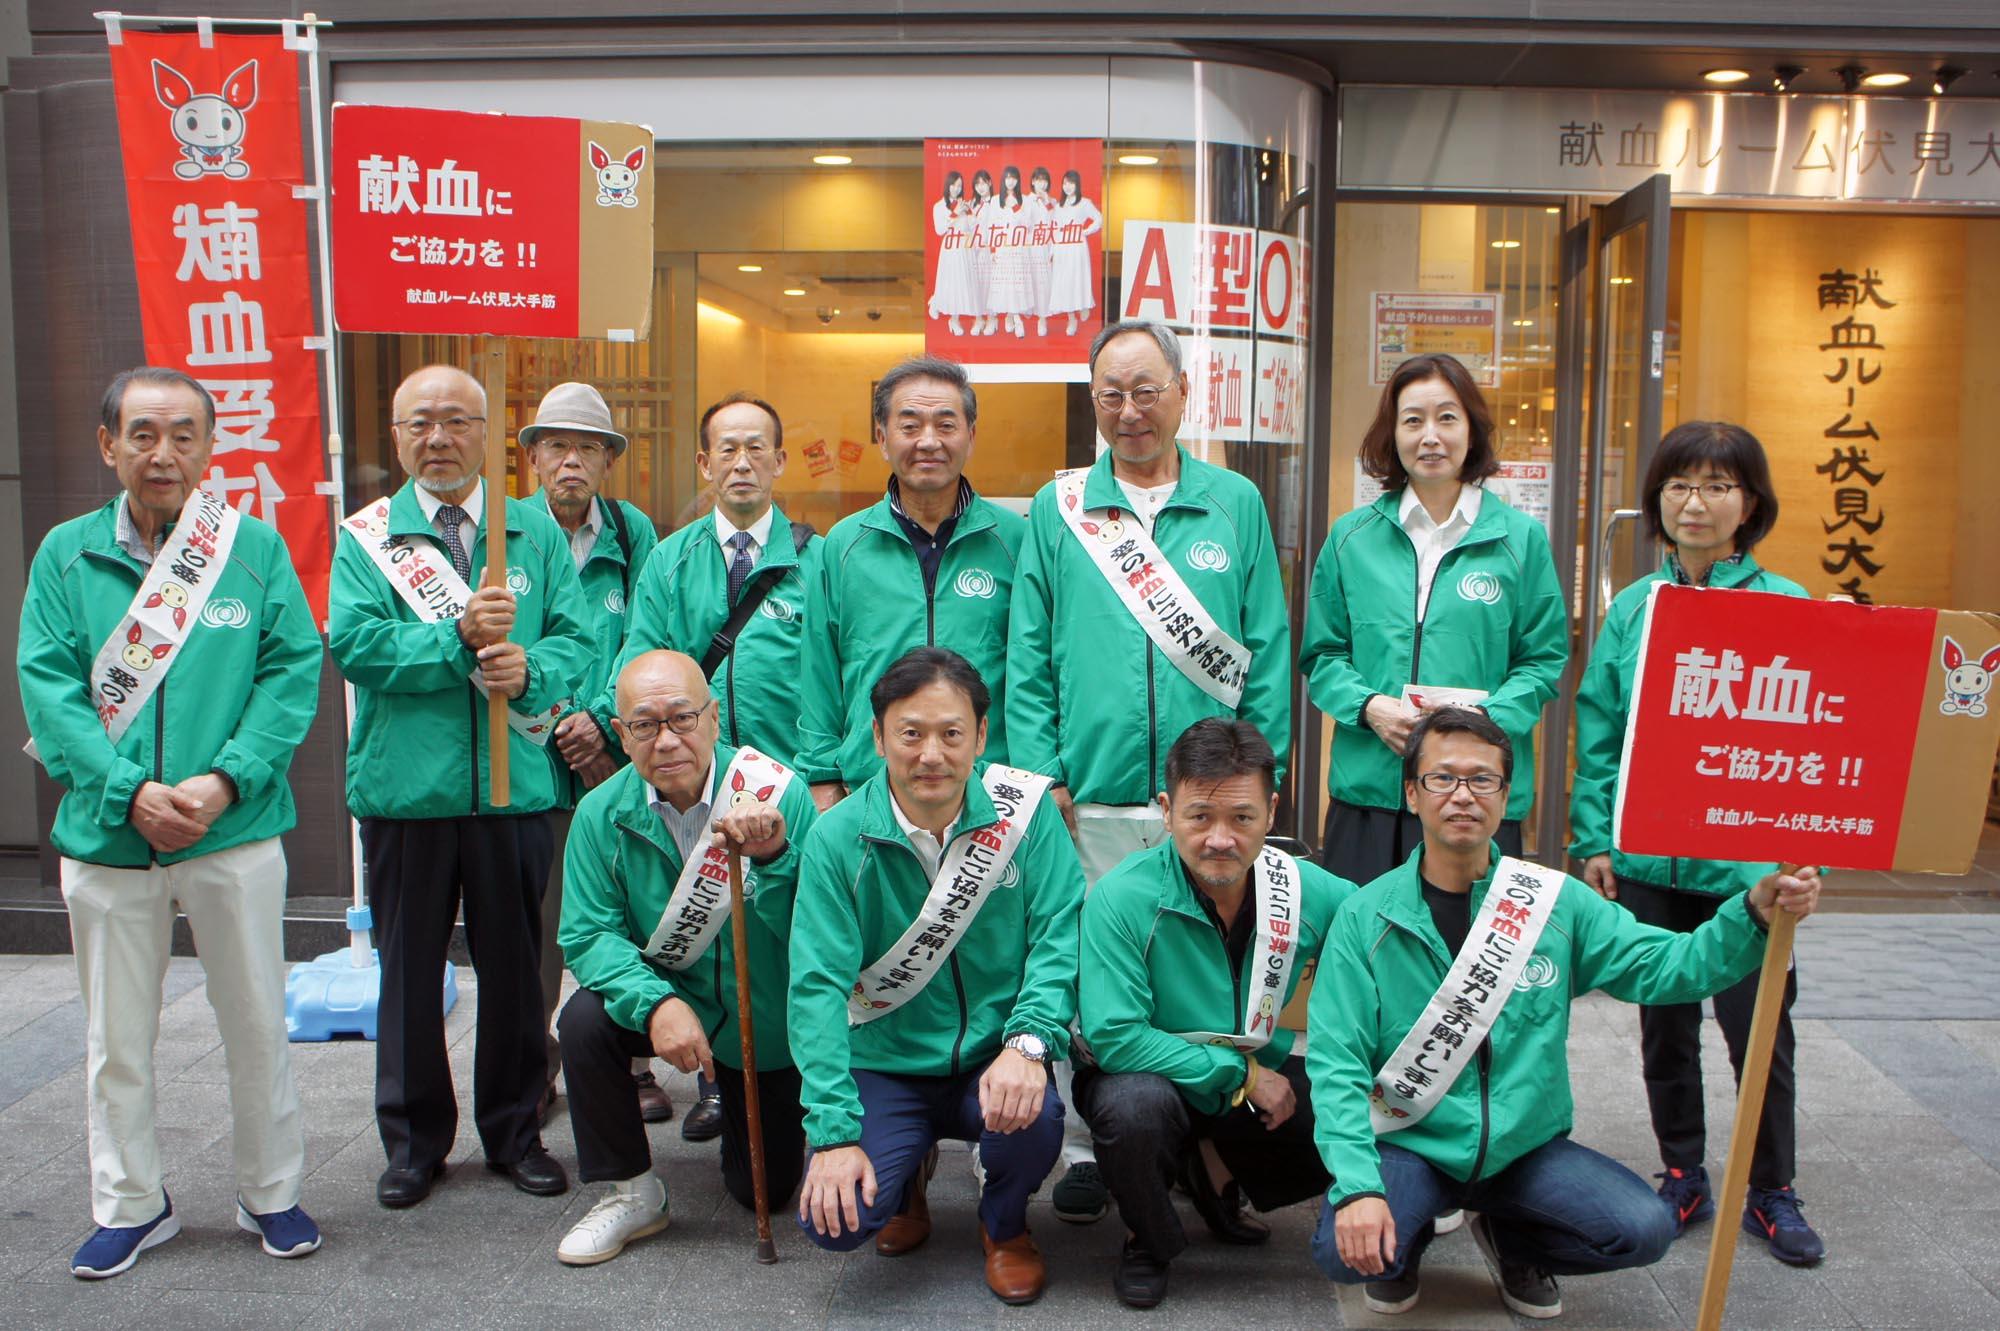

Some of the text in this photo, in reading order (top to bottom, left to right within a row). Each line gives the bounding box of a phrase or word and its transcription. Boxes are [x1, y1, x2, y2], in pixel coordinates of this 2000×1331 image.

[358, 154, 513, 216] 献血に
[390, 235, 504, 267] ご協力を
[944, 219, 1083, 250] みんなの献血
[406, 288, 556, 309] 献血ルーム伏見大手筋
[1669, 647, 1845, 724] 献血に
[1696, 745, 1825, 785] ご協力を
[1706, 807, 1874, 836] 献血ルーム伏見大手筋
[1394, 873, 1543, 1100] 愛の献血にご協力をお願いします
